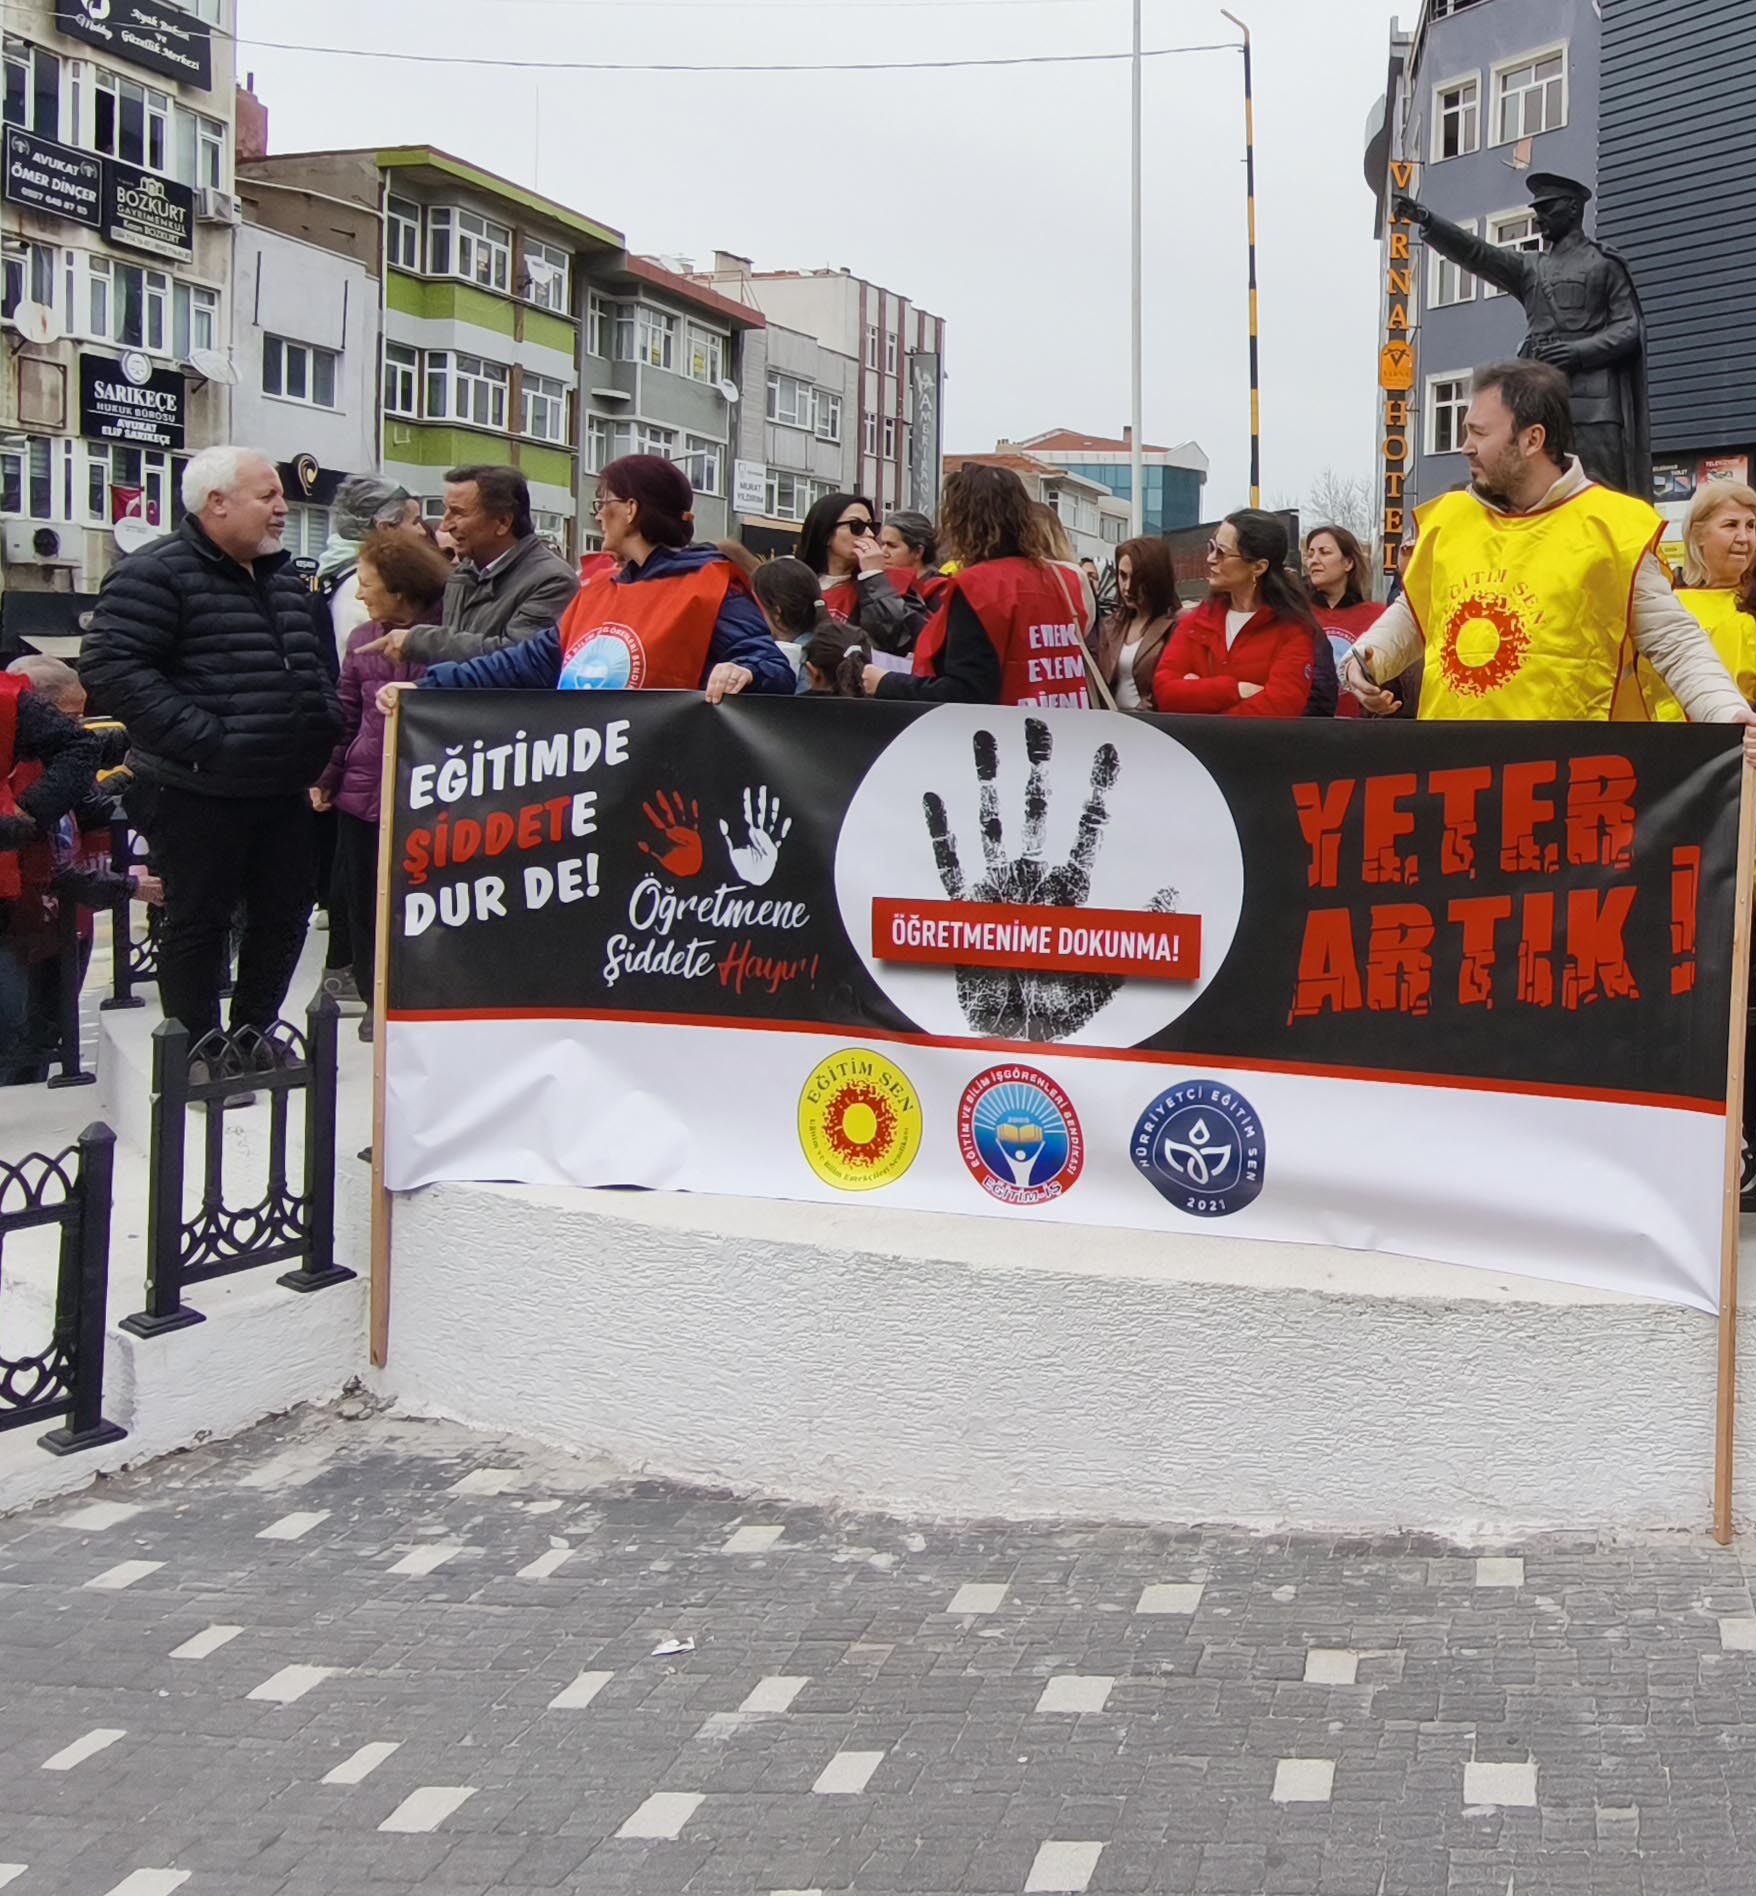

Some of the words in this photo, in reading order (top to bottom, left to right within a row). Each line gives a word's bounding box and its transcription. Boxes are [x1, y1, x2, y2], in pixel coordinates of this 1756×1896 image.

[11, 161, 50, 188] ÖMER
[51, 176, 97, 203] DİNÇER
[32, 152, 80, 176] AVUKAT
[116, 186, 187, 223] BOZKURT
[1386, 160, 1413, 331] VRNA
[93, 380, 178, 412] SARIKEÇE
[96, 402, 133, 416] HUKUK
[134, 407, 176, 423] BÜROSU
[1381, 400, 1409, 574] HOTEL
[1027, 654, 1086, 683] EYLEM
[408, 719, 631, 810] EĞİTİMDE
[402, 791, 598, 886] ŞİDDETE
[1291, 754, 1638, 888] YETER
[404, 875, 508, 938] DUR
[524, 852, 600, 910] DE!
[628, 871, 811, 936] Öğretmene
[602, 933, 718, 988] Şiddete
[891, 913, 1052, 955] ÖĞRETMENİME
[1058, 927, 1181, 963] DOKUNMA!
[1286, 885, 1641, 1028] ARTIK
[807, 1057, 873, 1105] EĞİTİM
[879, 1072, 914, 1113] SEN
[961, 1104, 972, 1119] VE
[965, 1077, 991, 1104] BİLİM
[1210, 1089, 1256, 1139] EĞİTİM
[1245, 1147, 1259, 1182] SEN
[1186, 1196, 1227, 1211] 2021
